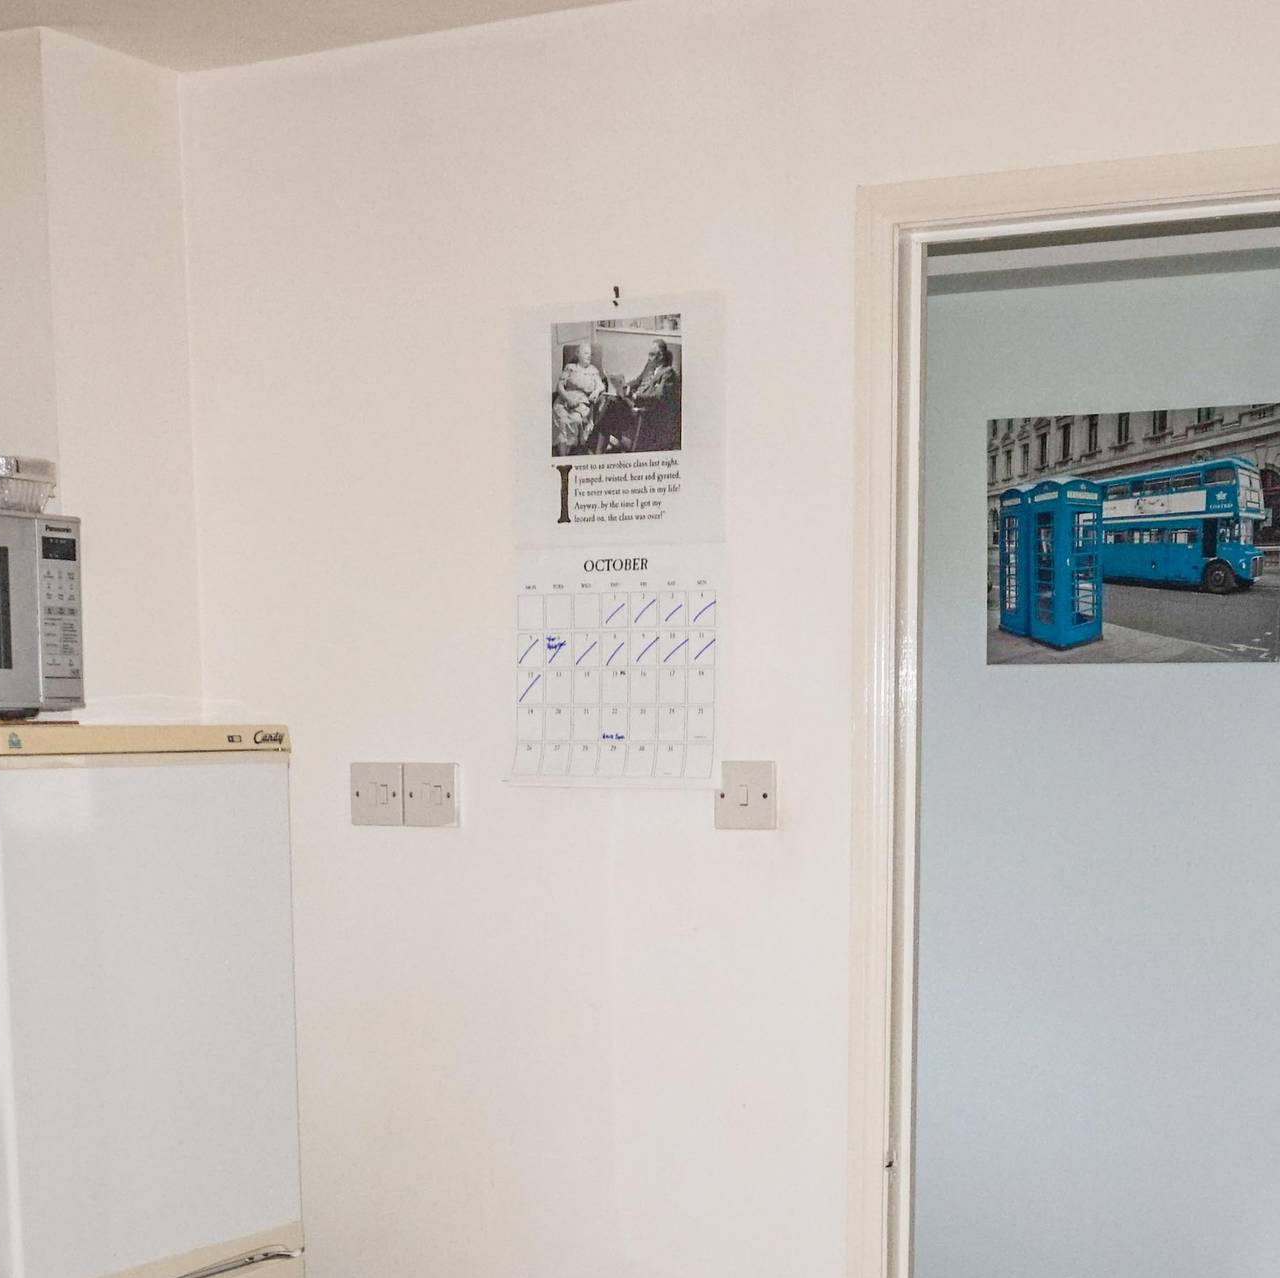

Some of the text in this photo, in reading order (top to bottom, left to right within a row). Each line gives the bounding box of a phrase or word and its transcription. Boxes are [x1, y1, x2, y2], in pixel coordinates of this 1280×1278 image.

[633, 459, 648, 467] class
[649, 459, 660, 467] last
[645, 472, 656, 480] and
[631, 486, 648, 494] much
[657, 487, 667, 495] my
[600, 500, 608, 510] by
[610, 500, 620, 508] the
[640, 501, 651, 509] got
[652, 500, 662, 508] my
[608, 513, 618, 521] the
[619, 513, 634, 521] class
[583, 557, 649, 572] OCTOBER
[253, 729, 284, 745] Candy
